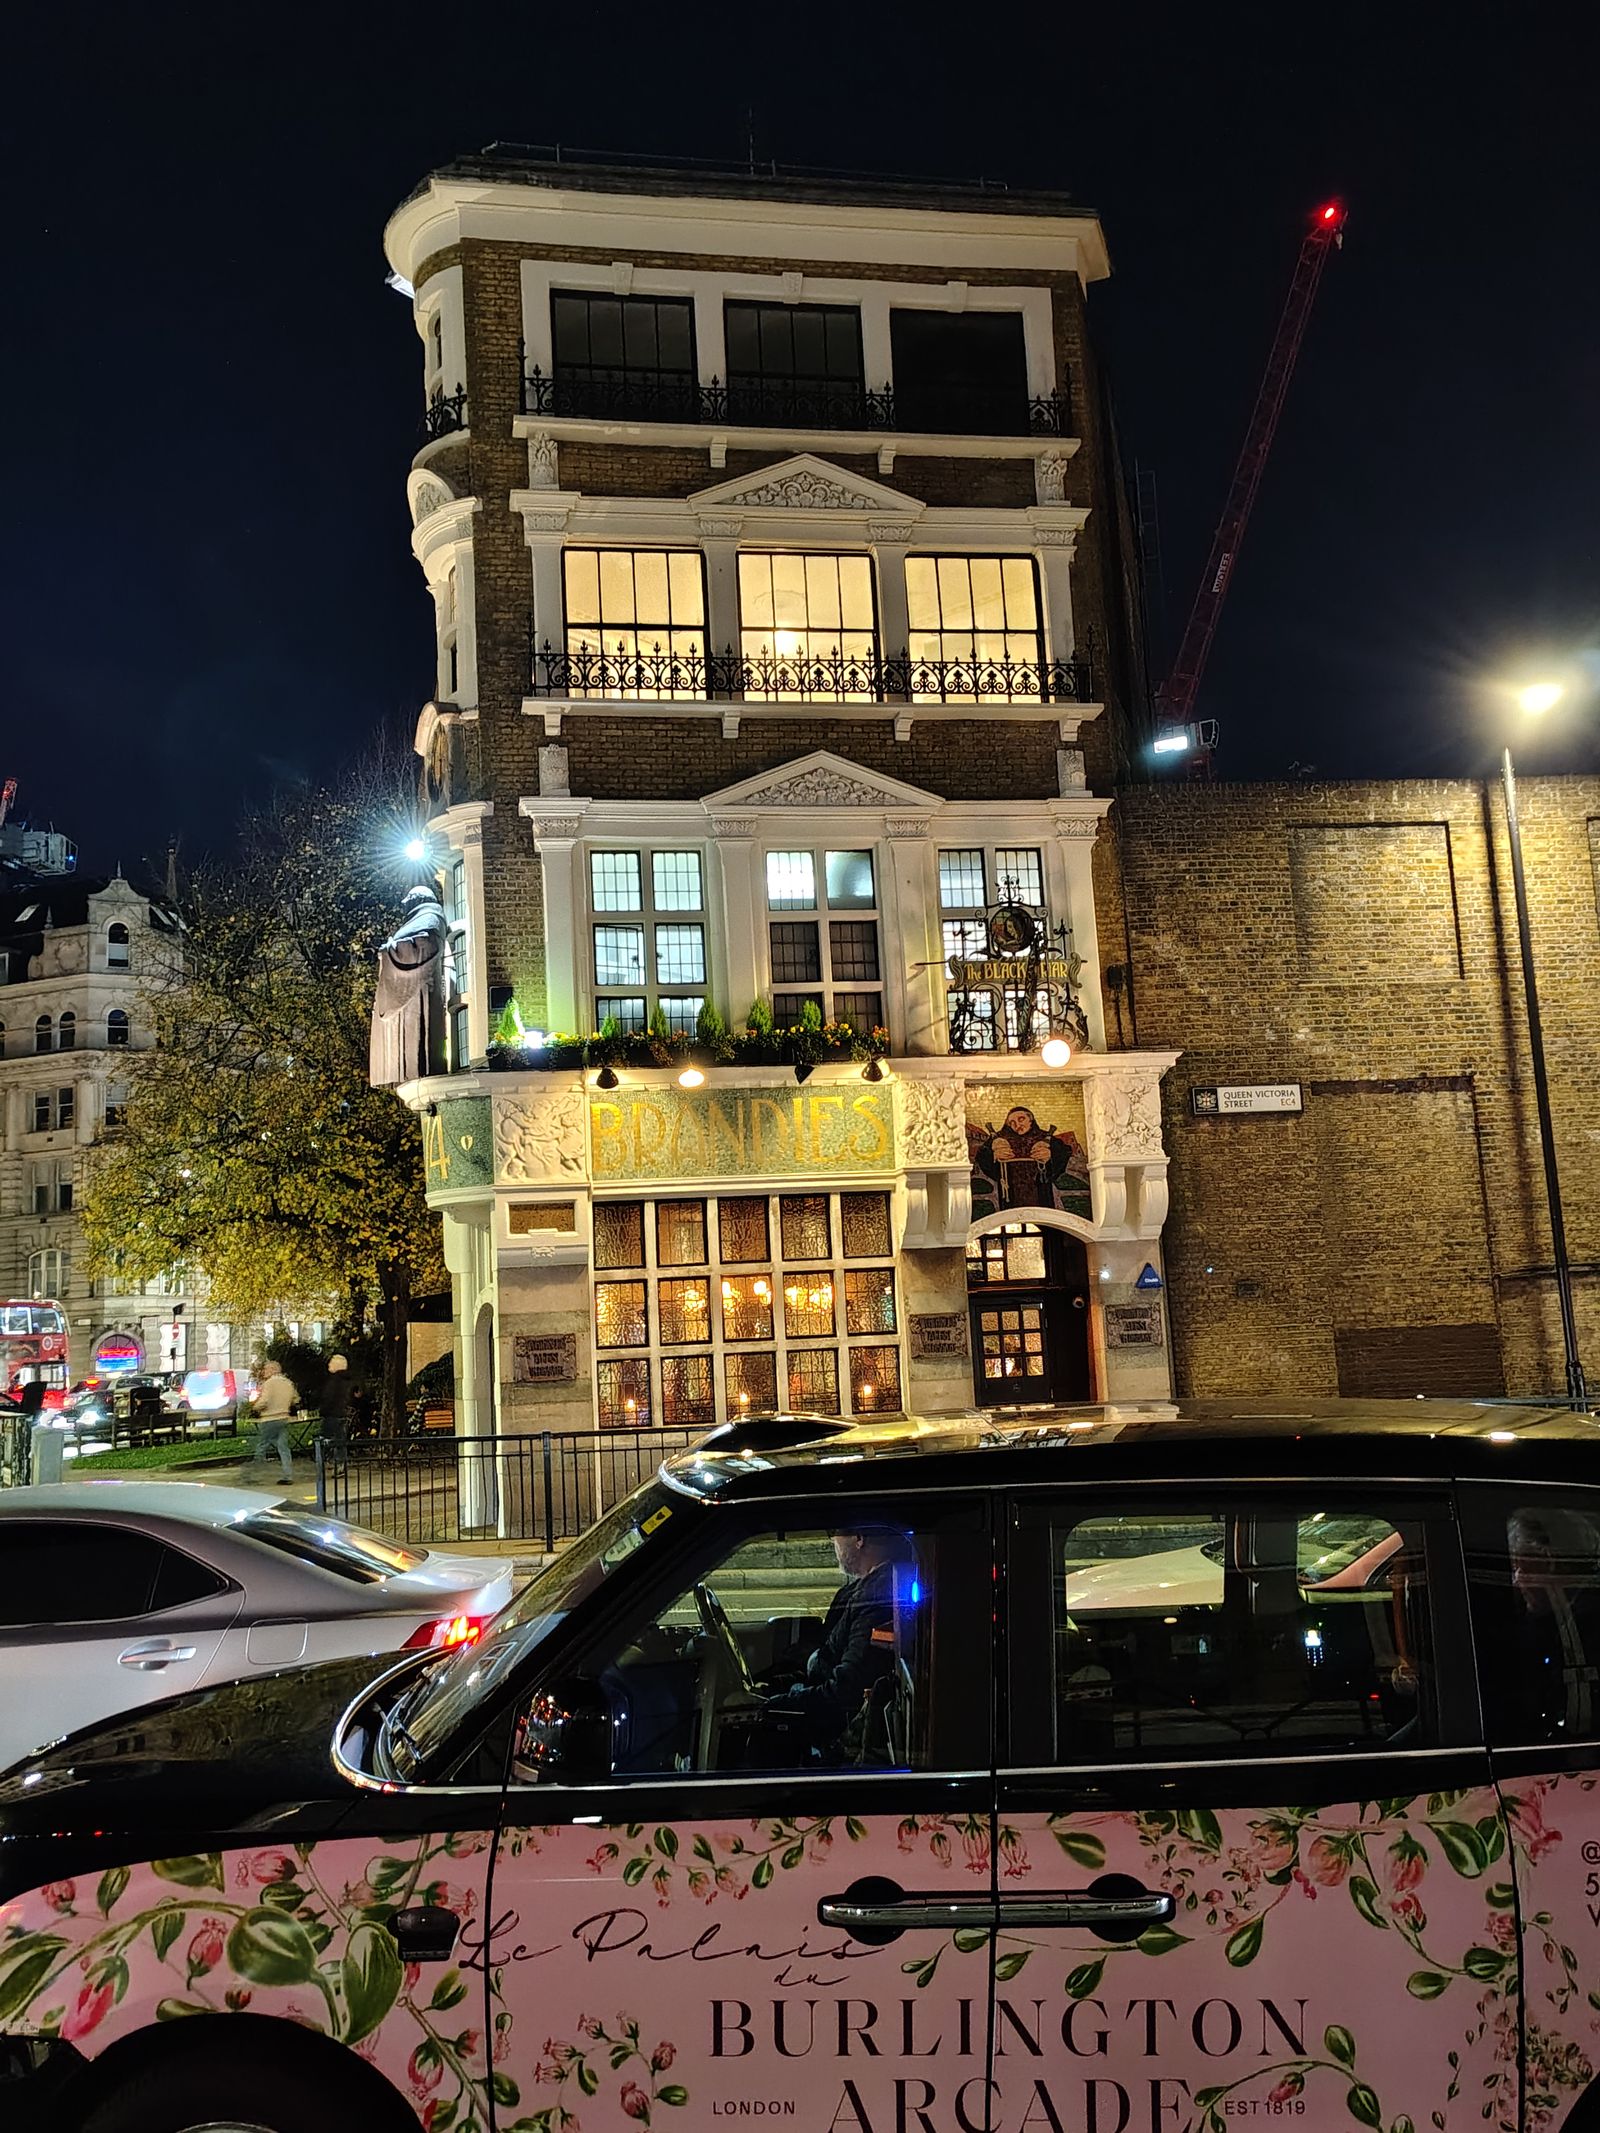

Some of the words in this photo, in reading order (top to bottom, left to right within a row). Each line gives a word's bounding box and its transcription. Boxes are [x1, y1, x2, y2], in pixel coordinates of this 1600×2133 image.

[964, 963, 982, 982] The
[984, 961, 1026, 980] BLACK
[1223, 1091, 1253, 1100] QUEEN
[1255, 1089, 1296, 1098] VICTORIA
[1224, 1100, 1253, 1108] STREET
[1280, 1098, 1296, 1106] EC4
[590, 1095, 888, 1172] BRANDIES
[458, 1909, 562, 1971] Le
[572, 1908, 885, 1962] Palais
[773, 1964, 851, 1987] du
[709, 1999, 1309, 2058] BURLINGTON
[712, 2100, 796, 2115] LONDON
[825, 2078, 1194, 2133] ARCADE
[1224, 2101, 1260, 2115] EST
[1264, 2100, 1306, 2115] 1819
